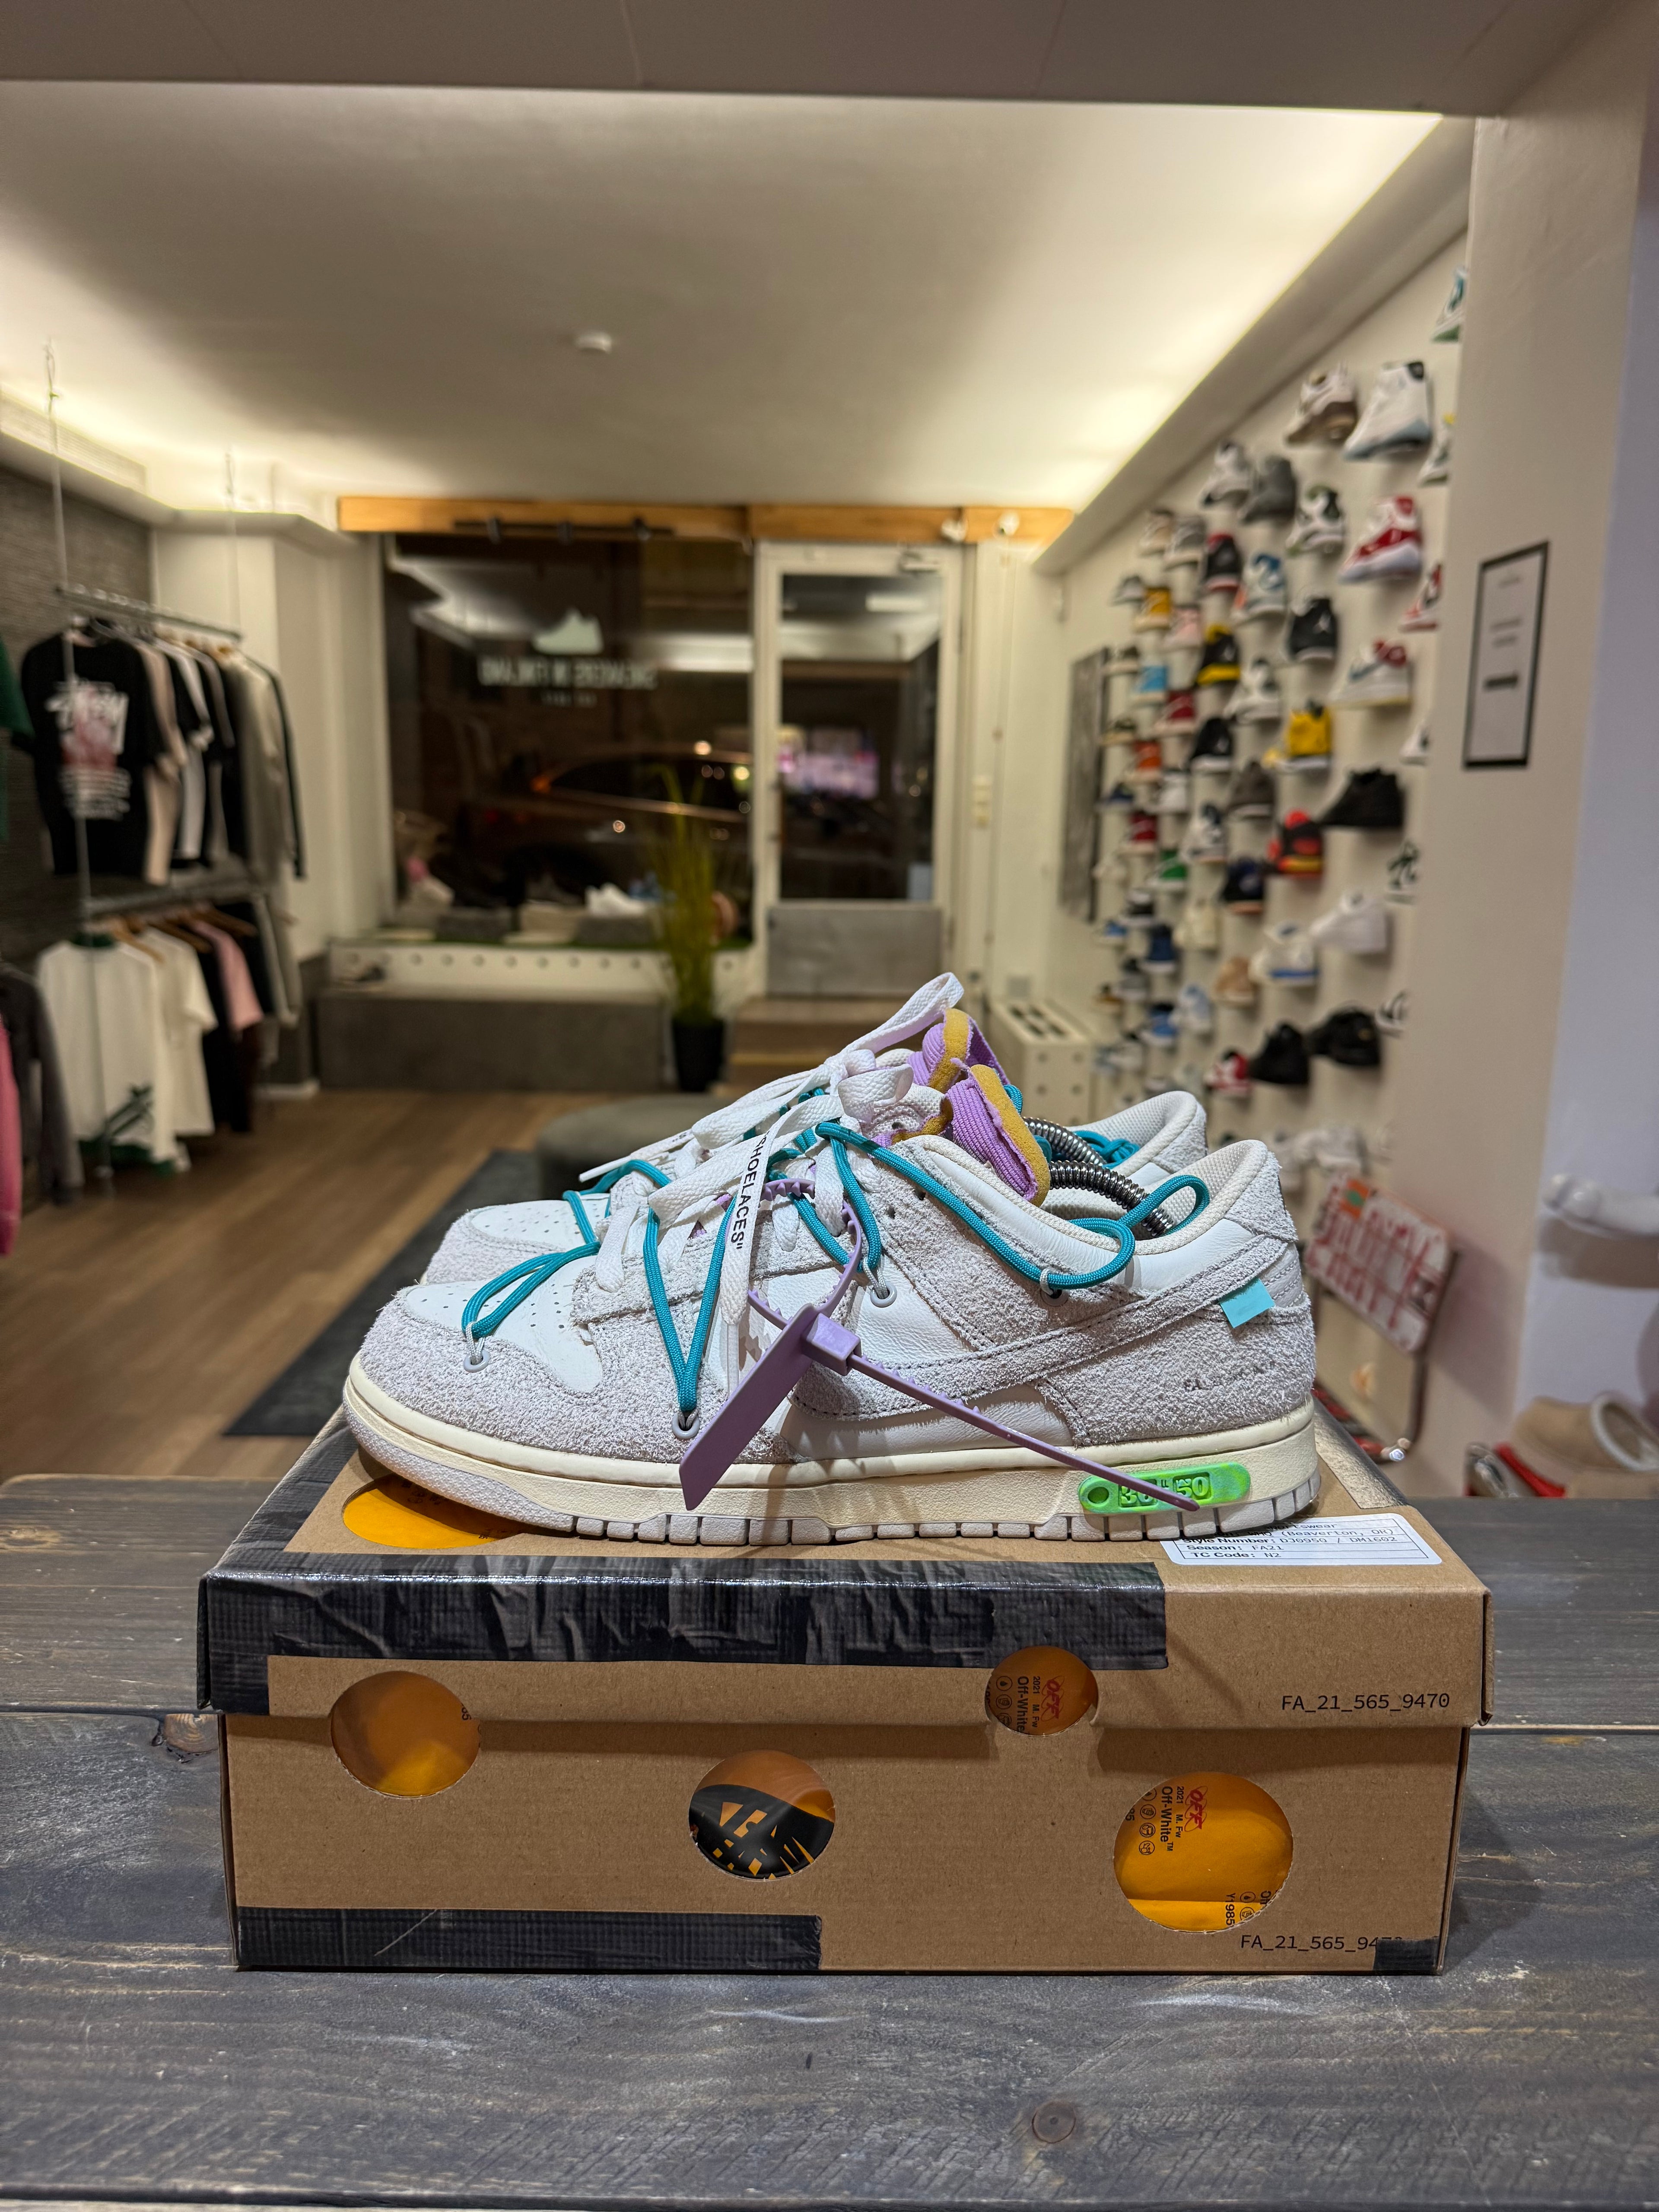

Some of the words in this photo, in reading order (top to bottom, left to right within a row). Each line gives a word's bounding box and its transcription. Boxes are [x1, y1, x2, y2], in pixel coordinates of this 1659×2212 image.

[1176, 1476, 1209, 1497] 50
[1044, 1678, 1061, 1720] OFF
[1281, 1693, 1450, 1713] FA_21_565_9470
[1032, 1704, 1040, 1713] M.
[1032, 1716, 1039, 1728] Fw
[1176, 1786, 1184, 1804] 2021
[1188, 1788, 1205, 1831] OFF
[1176, 1814, 1183, 1824] M.
[1175, 1826, 1183, 1838] Fw
[1240, 1935, 1402, 1952] FA_21_565_94
